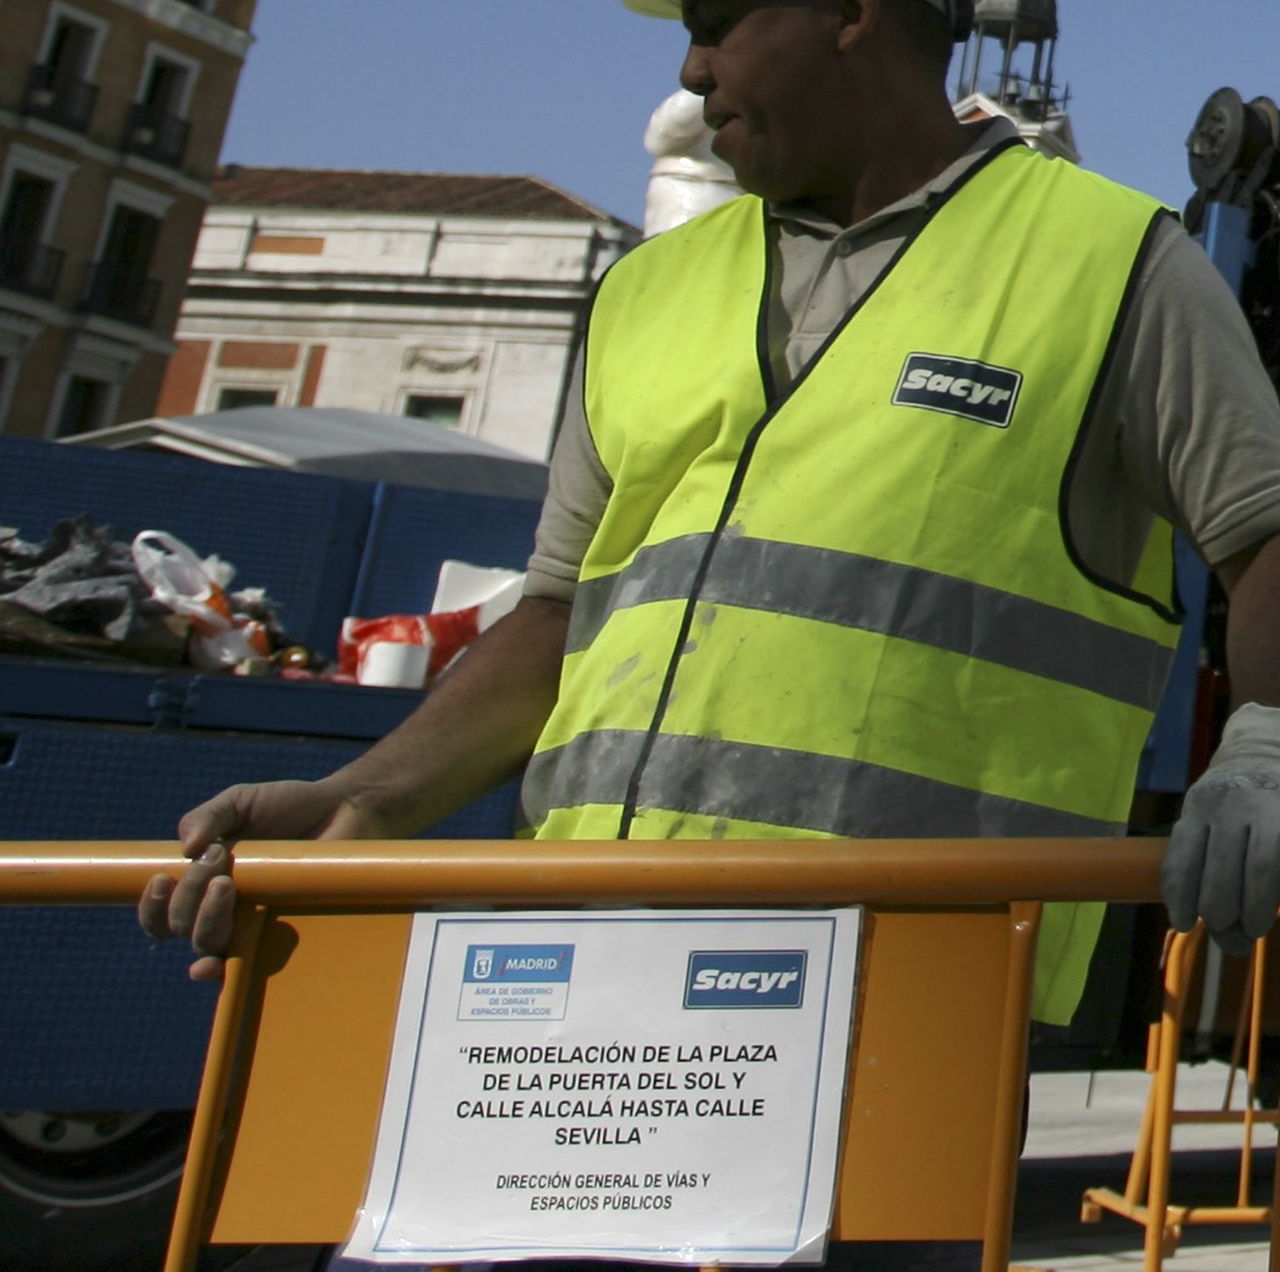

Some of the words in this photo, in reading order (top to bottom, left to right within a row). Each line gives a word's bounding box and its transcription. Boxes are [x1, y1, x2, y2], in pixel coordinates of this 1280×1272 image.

[902, 368, 1012, 406] Sacyr
[505, 958, 557, 970] MADRID
[692, 969, 799, 993] Sacyr
[499, 987, 509, 996] DE
[511, 987, 553, 996] GOBIERNO
[489, 997, 499, 1006] DE
[501, 997, 529, 1006] OBRAS
[471, 1008, 509, 1016] ESPACIOS
[643, 1046, 671, 1063] DE
[677, 1046, 703, 1063] LA
[710, 1045, 778, 1063] PLAZA
[483, 1073, 511, 1091] DE
[517, 1073, 543, 1091] LA
[549, 1073, 631, 1090] PUERTA
[638, 1073, 677, 1090] DEL
[684, 1072, 726, 1090] SOL
[733, 1072, 746, 1089] Y
[456, 1100, 525, 1118] CALLE
[529, 1095, 614, 1118] ALCALÁ
[620, 1099, 690, 1117] HASTA
[695, 1099, 765, 1117] CALLE
[555, 1127, 641, 1145] SEVILLA
[496, 1171, 571, 1189] DIRECCIÓN
[574, 1174, 639, 1188] GENERAL
[643, 1174, 663, 1188] DE
[667, 1170, 698, 1188] VÍAS
[702, 1173, 711, 1187] Y
[530, 1195, 599, 1211] ESPACIOS
[602, 1192, 672, 1210] PÚBLICOS
